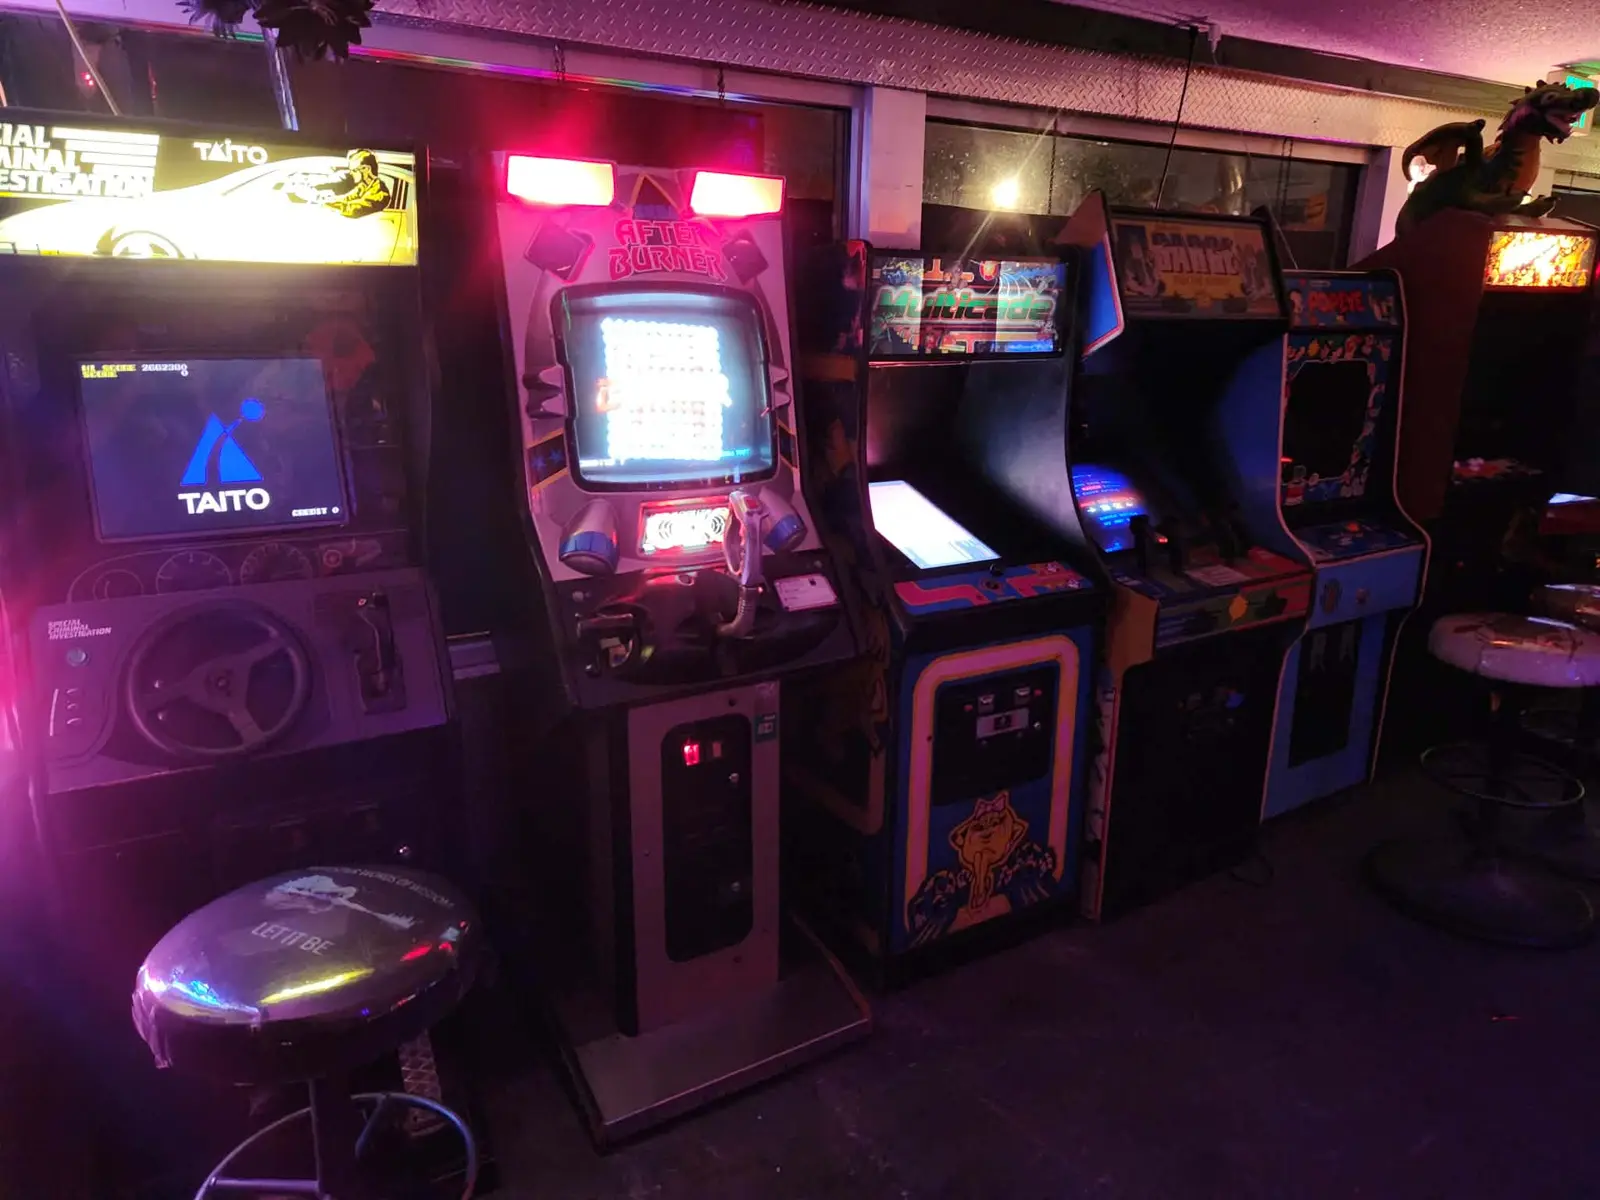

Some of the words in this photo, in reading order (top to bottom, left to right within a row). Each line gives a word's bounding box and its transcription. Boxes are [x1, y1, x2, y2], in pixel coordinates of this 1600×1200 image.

[0, 123, 51, 148] IAL
[193, 138, 268, 165] TAITO
[614, 219, 711, 246] AFTER
[608, 246, 728, 281] BURNER
[873, 288, 1056, 321] Multicade
[178, 488, 270, 514] TAITO
[251, 922, 290, 940] LET
[281, 931, 308, 945] IT
[299, 936, 335, 956] BE
